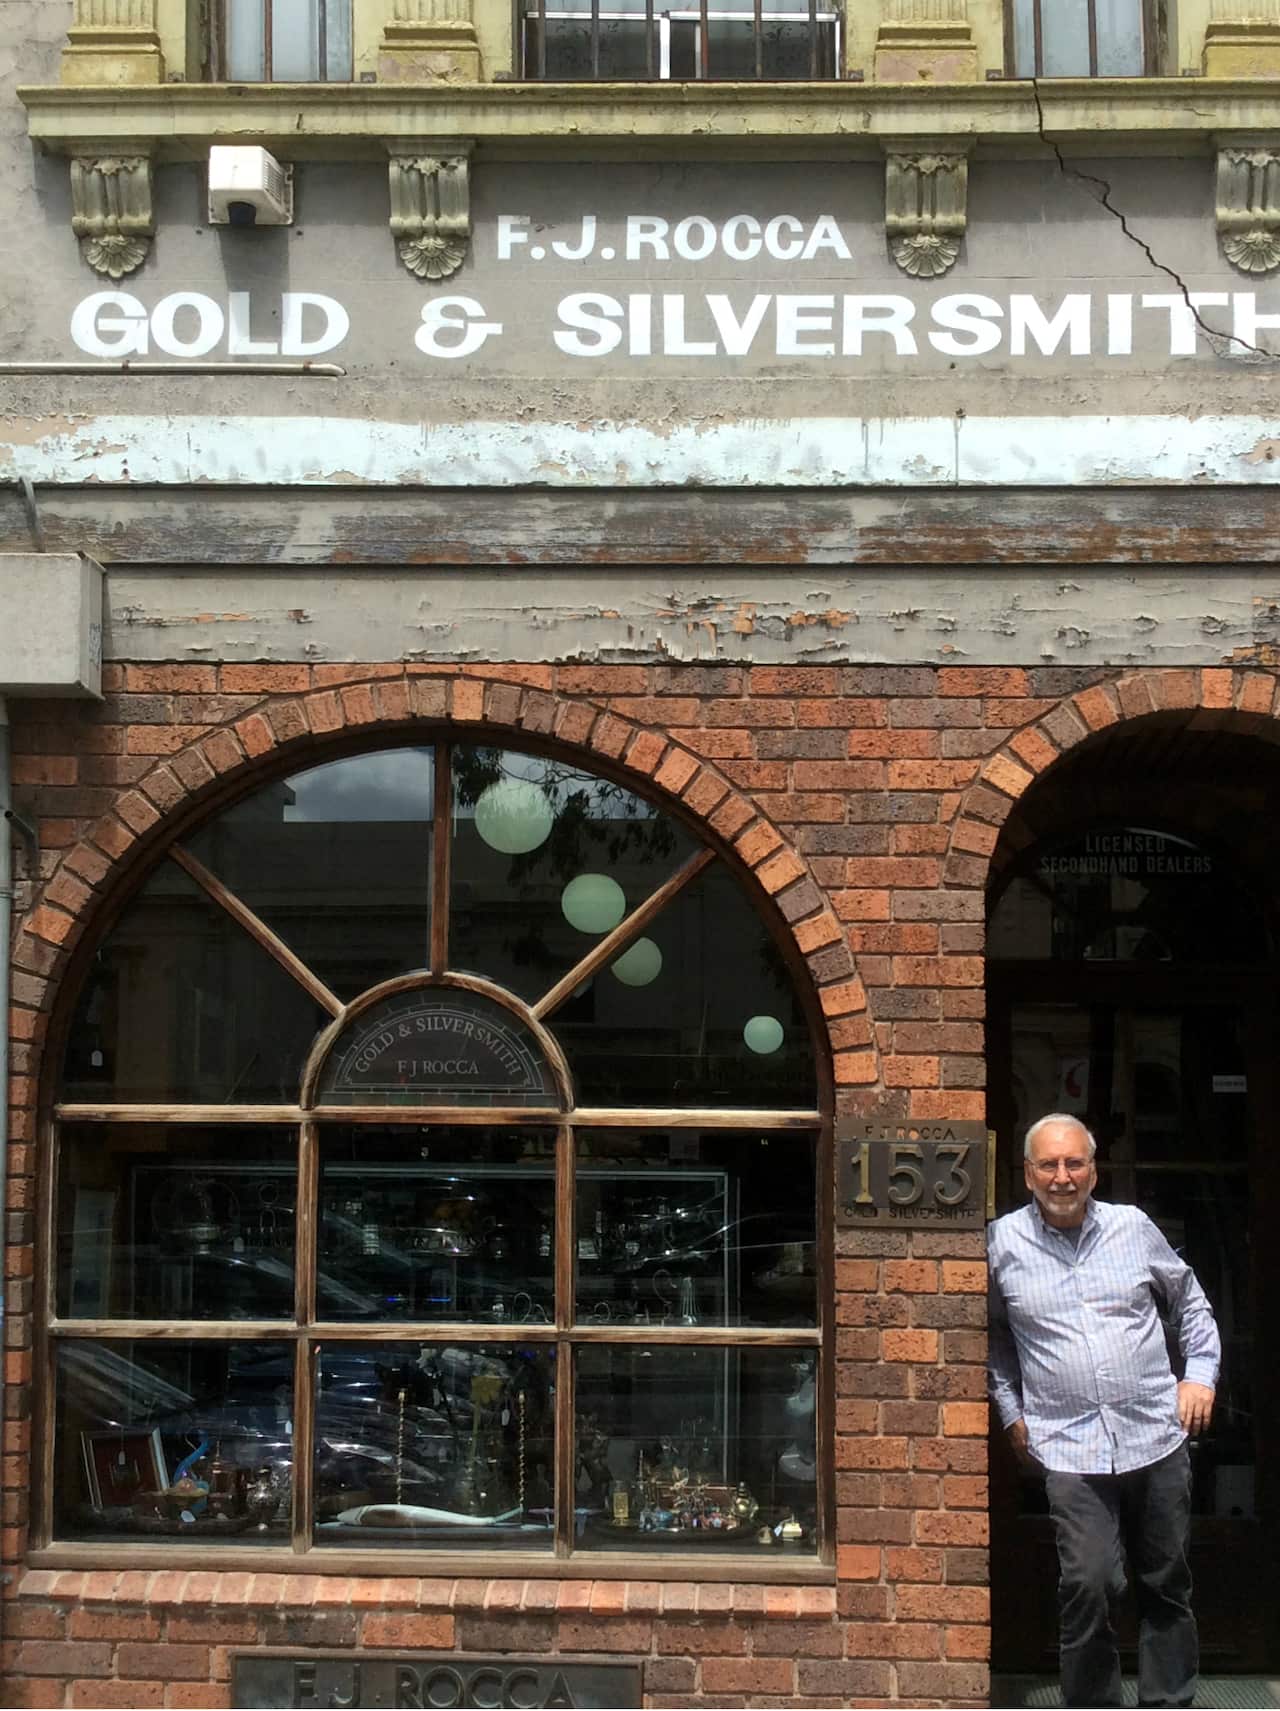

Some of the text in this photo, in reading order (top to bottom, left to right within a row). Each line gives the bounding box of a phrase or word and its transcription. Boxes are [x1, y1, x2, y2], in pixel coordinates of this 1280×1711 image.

[70, 291, 1280, 359] GOLD & SILVERSMITH
[1085, 835, 1167, 853] LICENSED
[1040, 855, 1213, 873] SECONDHAND DEALERS
[354, 1015, 522, 1074] GOLD & SILVERSMITH
[423, 1060, 480, 1074] ROCCA
[851, 1142, 972, 1206] 153
[844, 1206, 879, 1218] GLD
[395, 1664, 577, 1709] ROCCA
